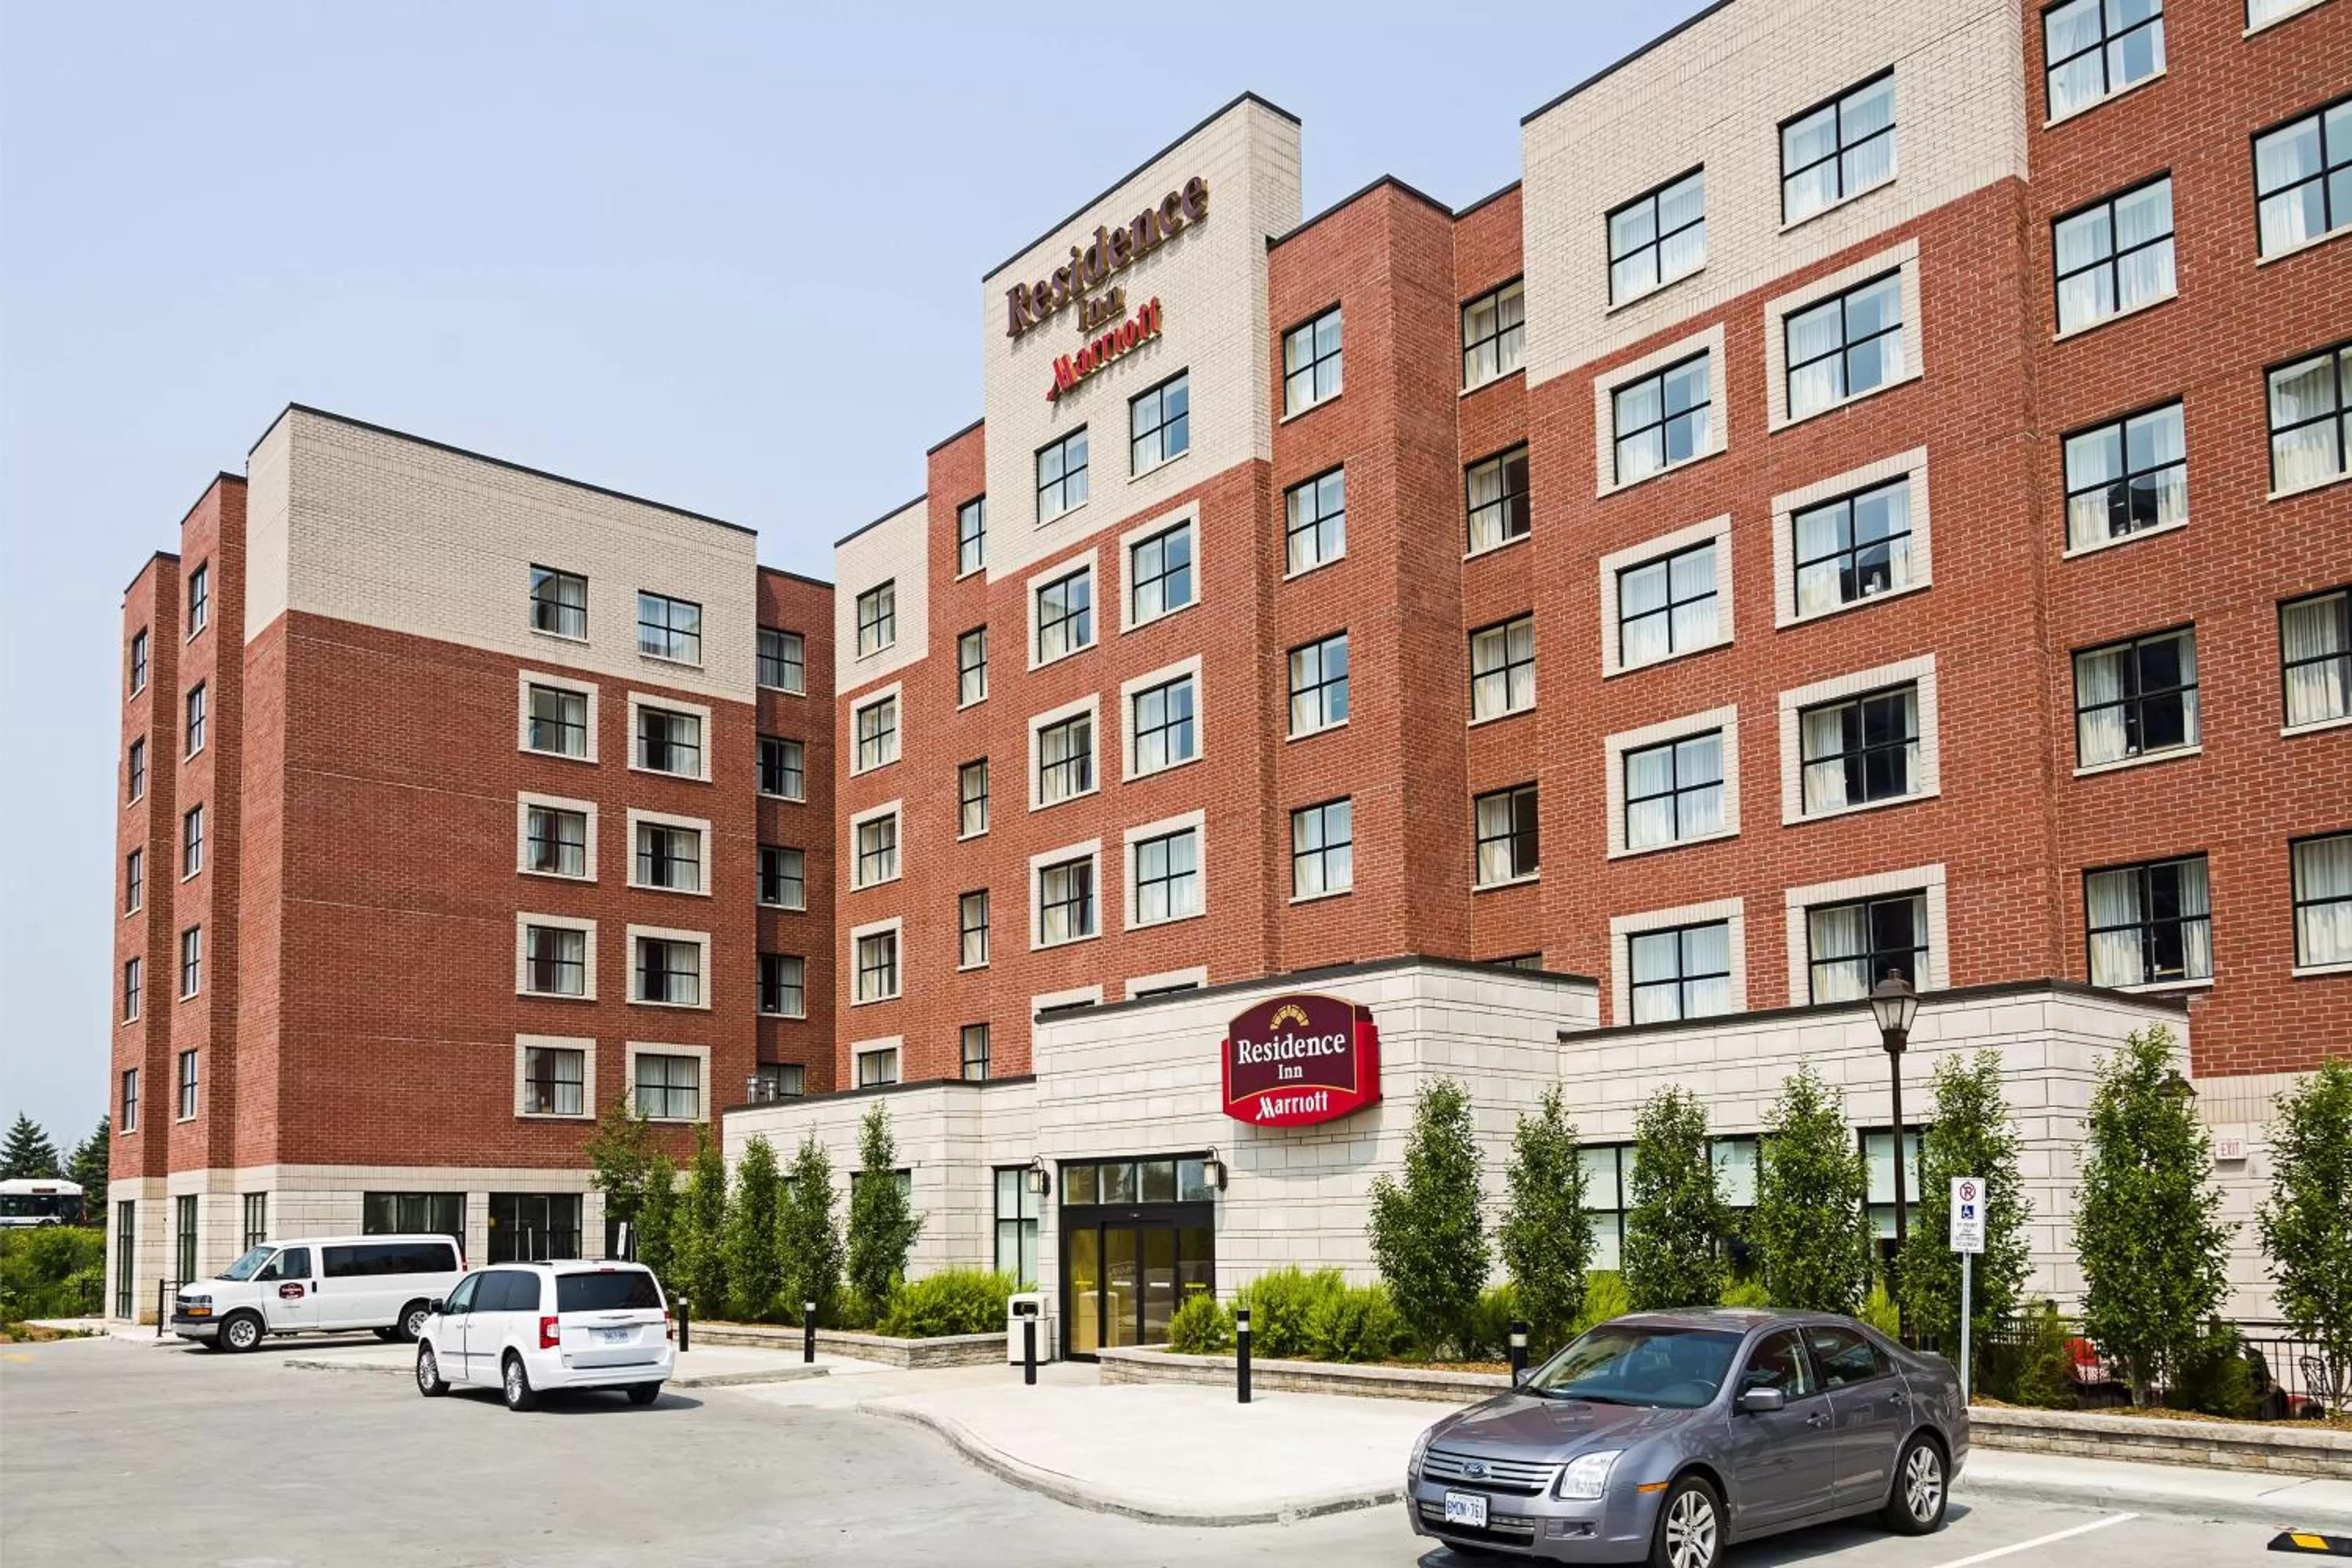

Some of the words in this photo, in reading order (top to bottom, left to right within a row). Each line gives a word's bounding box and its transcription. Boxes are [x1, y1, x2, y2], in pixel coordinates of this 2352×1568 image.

[1005, 176, 1209, 338] Residence
[1076, 286, 1126, 332] Inn
[1046, 296, 1163, 401] Marriott
[1236, 1031, 1346, 1064] Residence
[1276, 1064, 1304, 1080] Inn
[1255, 1091, 1329, 1121] Marriott
